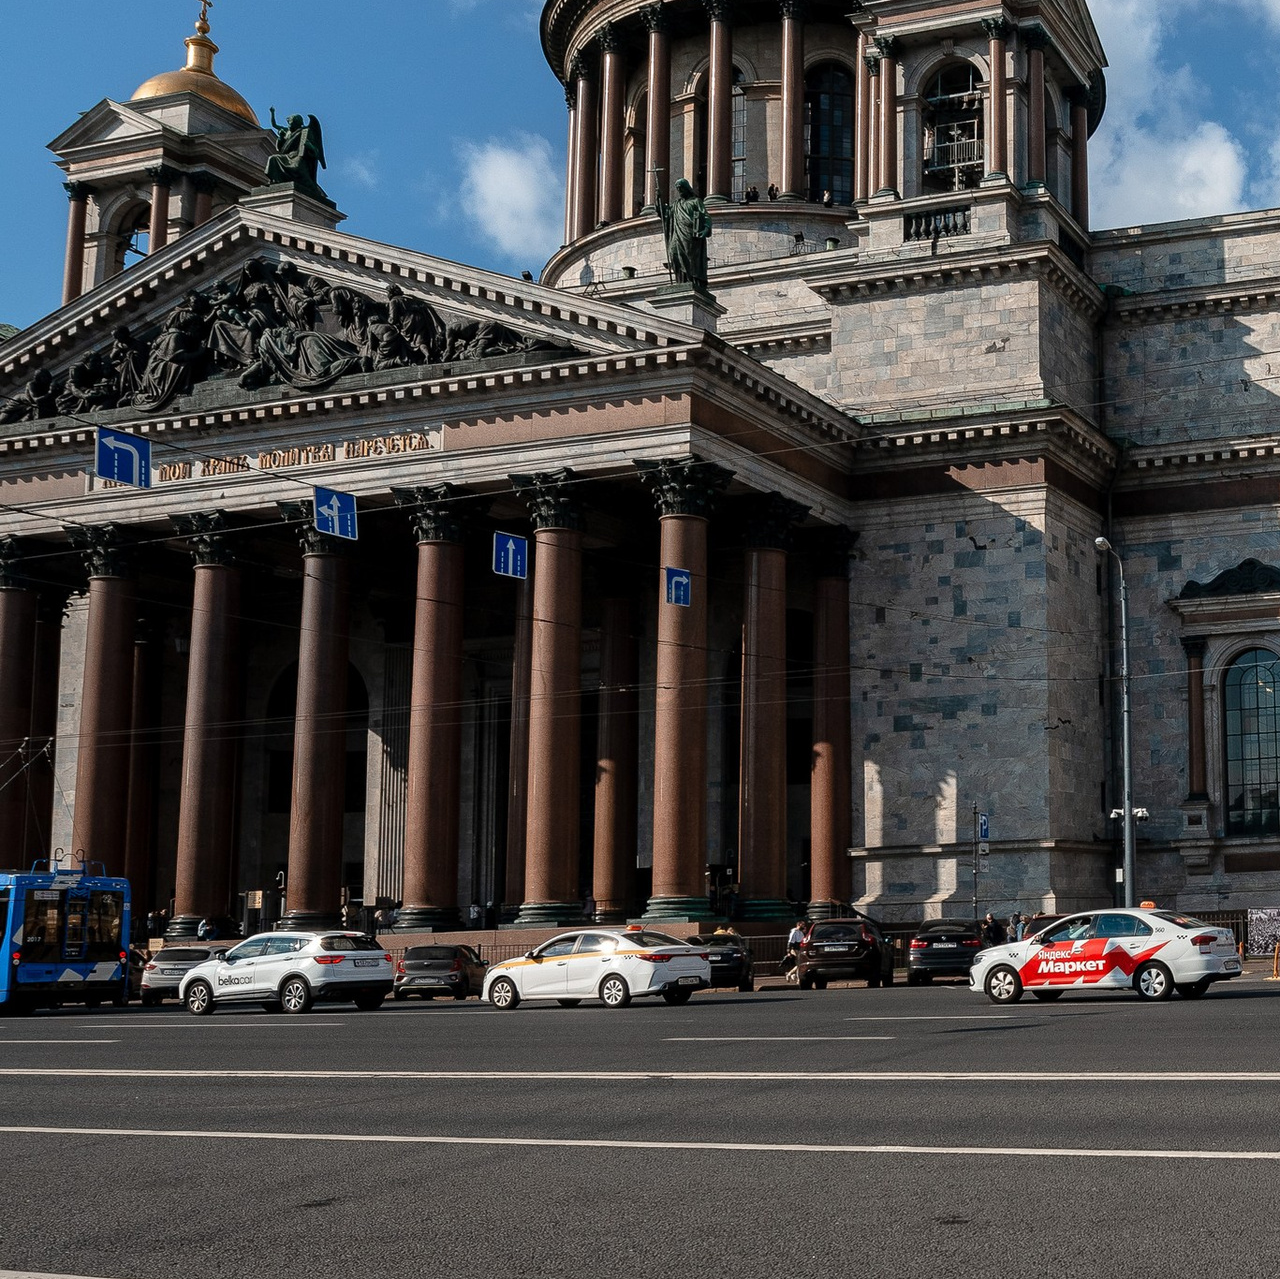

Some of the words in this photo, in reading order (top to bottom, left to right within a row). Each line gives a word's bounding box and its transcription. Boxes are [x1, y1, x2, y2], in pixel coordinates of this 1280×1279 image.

[1038, 949, 1072, 961] Яндекс
[1037, 959, 1106, 974] Маркет
[218, 975, 253, 986] belkacar
